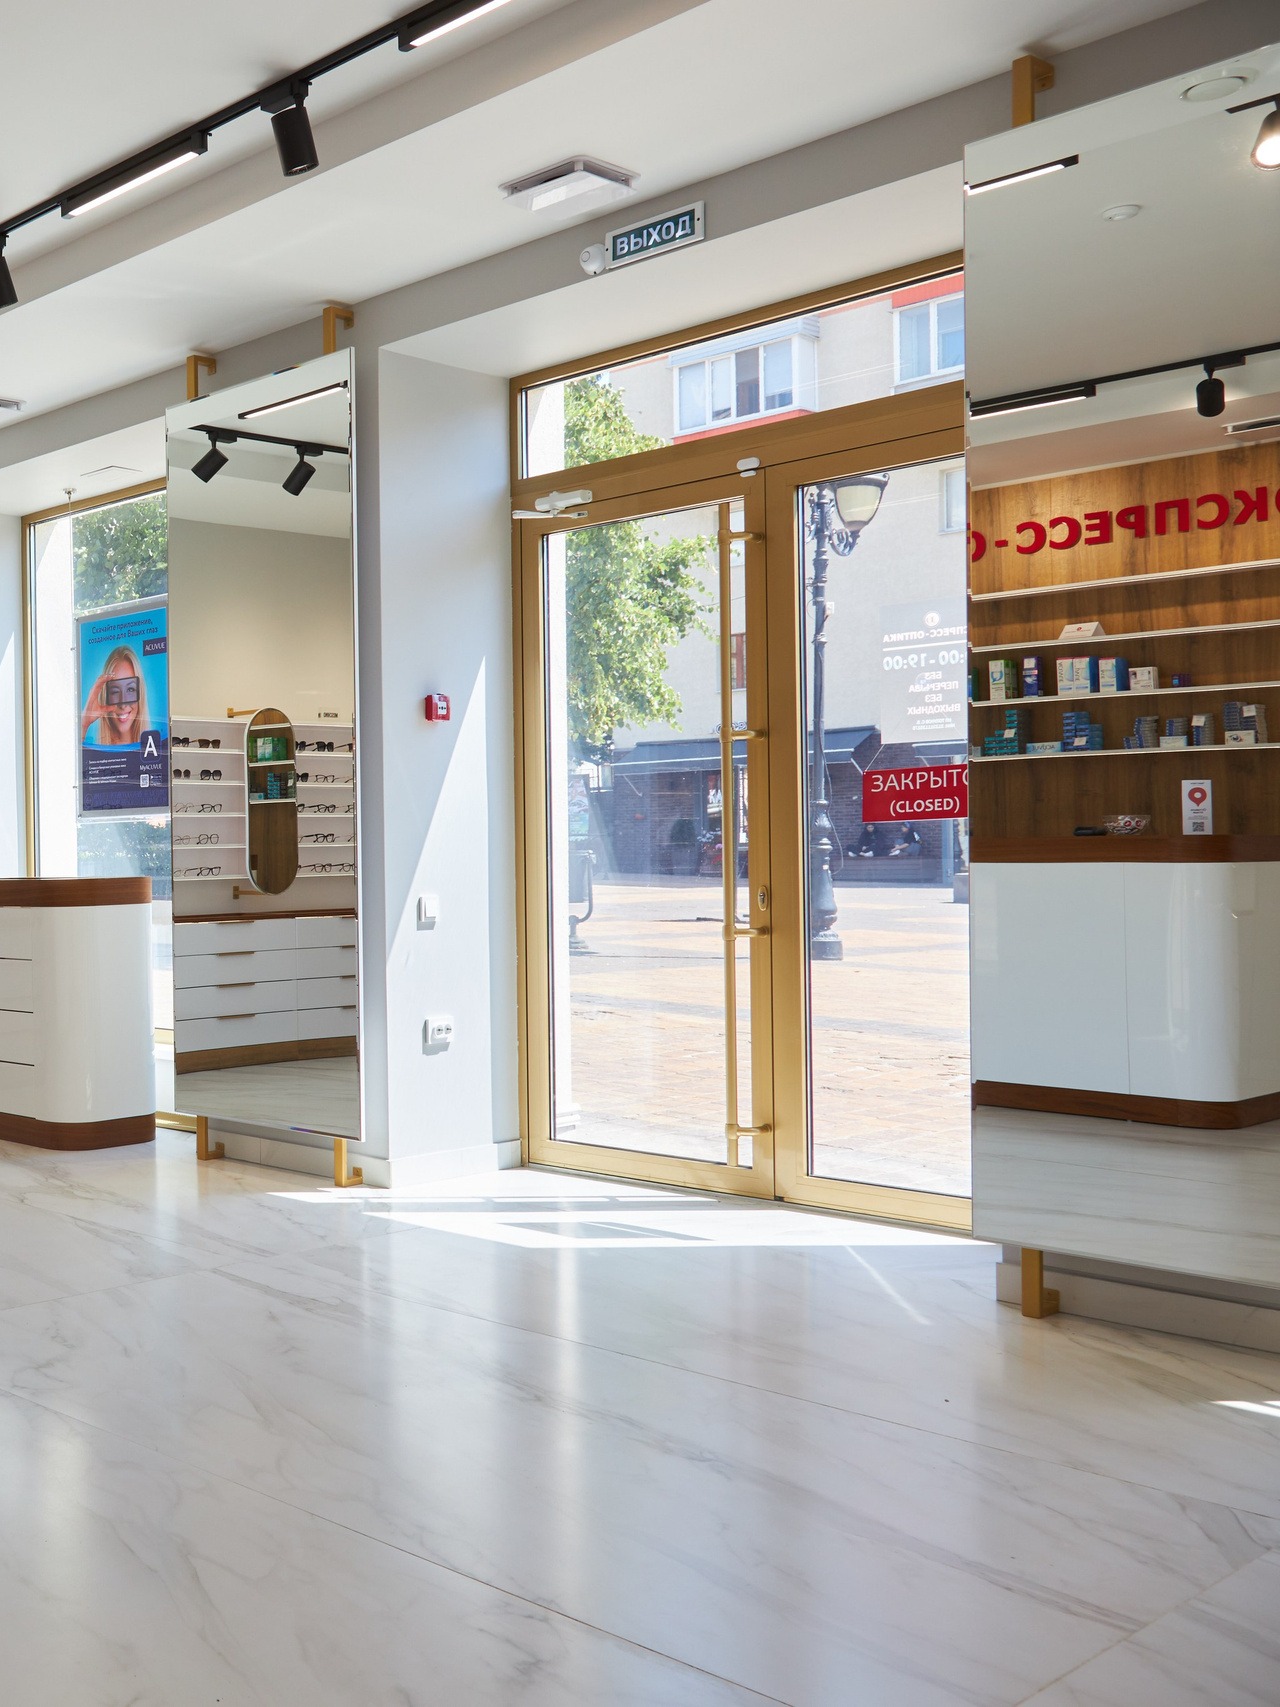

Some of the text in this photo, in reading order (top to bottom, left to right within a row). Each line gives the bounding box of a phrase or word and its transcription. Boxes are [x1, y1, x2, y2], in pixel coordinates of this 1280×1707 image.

[615, 214, 692, 257] ВЫХОД
[88, 626, 158, 645] созданное для Ваших глаз
[91, 619, 153, 635] Скачайте приложение,
[144, 641, 166, 652] ACUVUE
[143, 735, 158, 758] A
[889, 796, 960, 817] (CLOSED)
